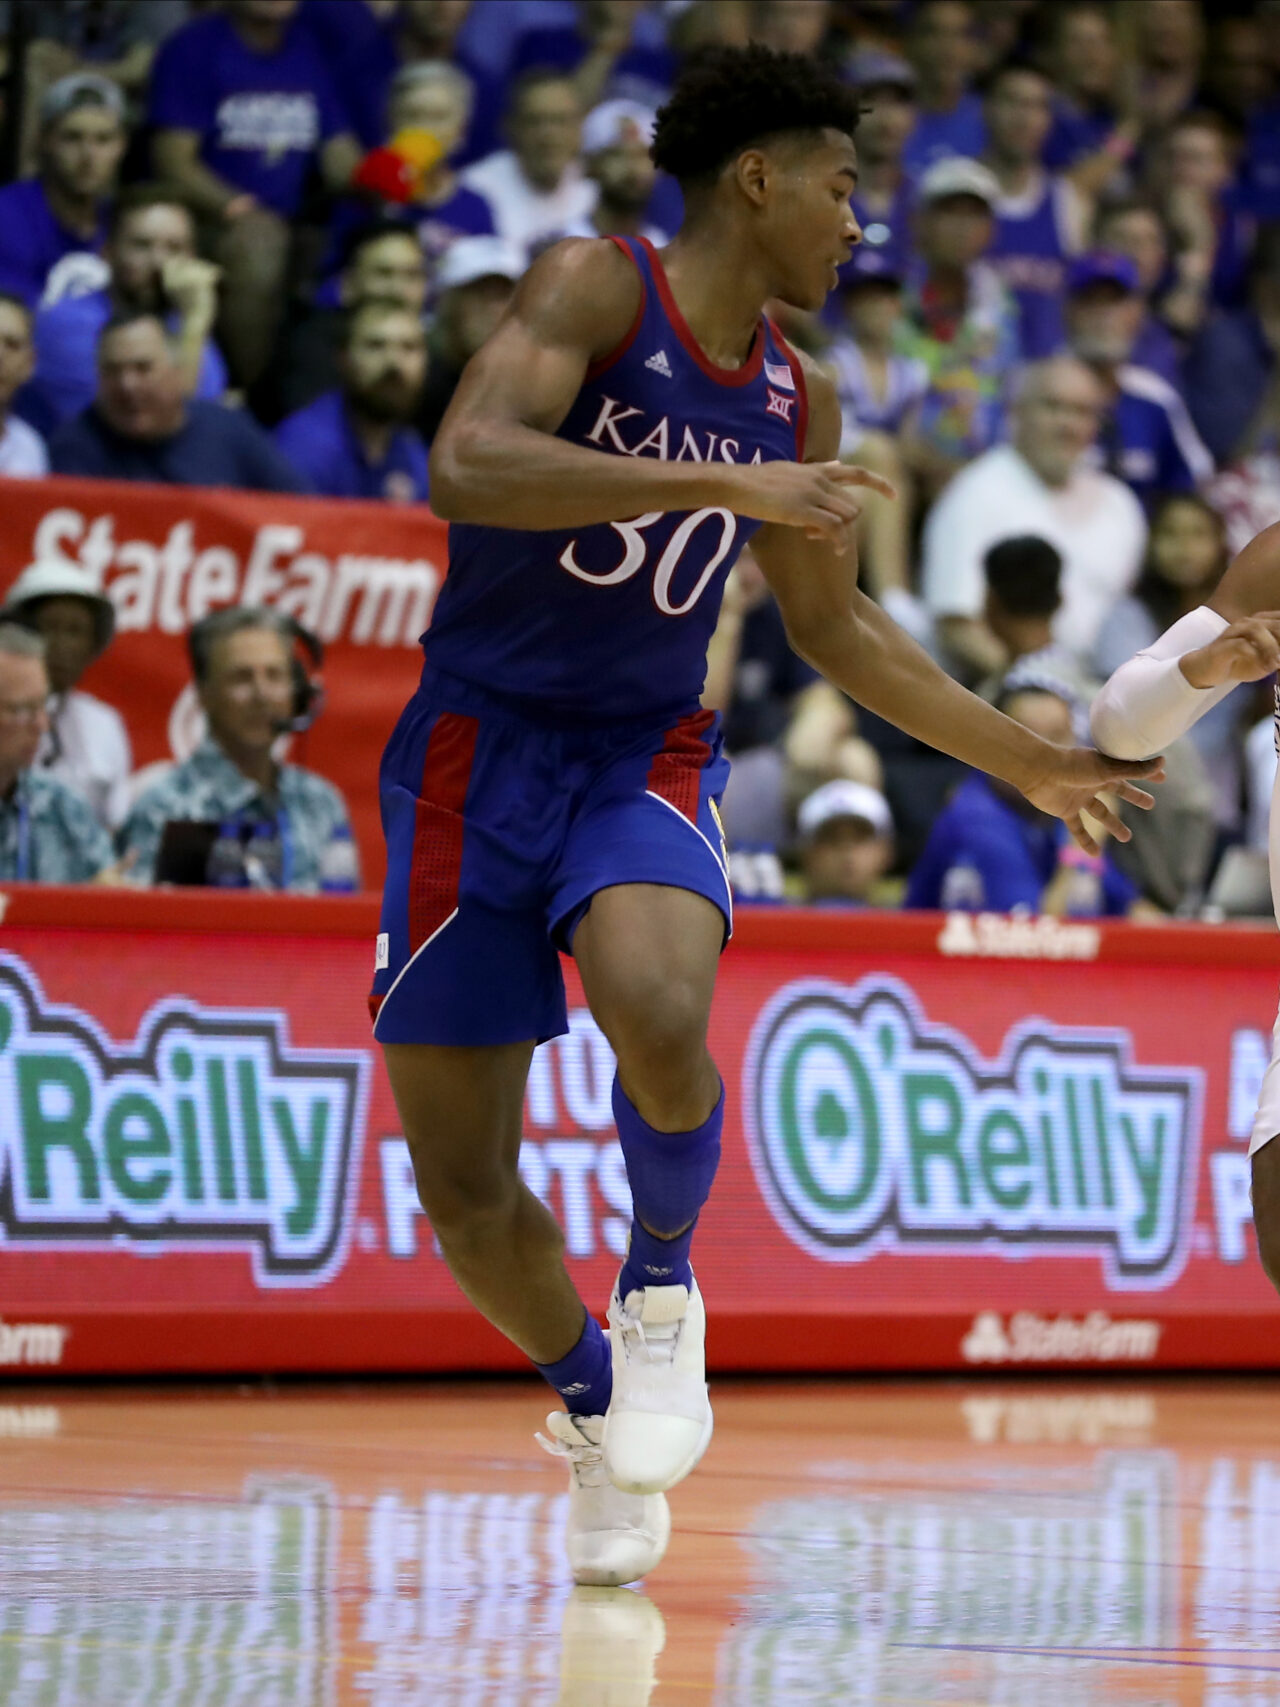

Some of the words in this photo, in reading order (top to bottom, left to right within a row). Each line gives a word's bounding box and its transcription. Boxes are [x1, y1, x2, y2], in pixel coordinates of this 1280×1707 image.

[766, 386, 795, 423] XII
[558, 506, 737, 616] 30
[778, 1020, 1167, 1242] O'Reilly
